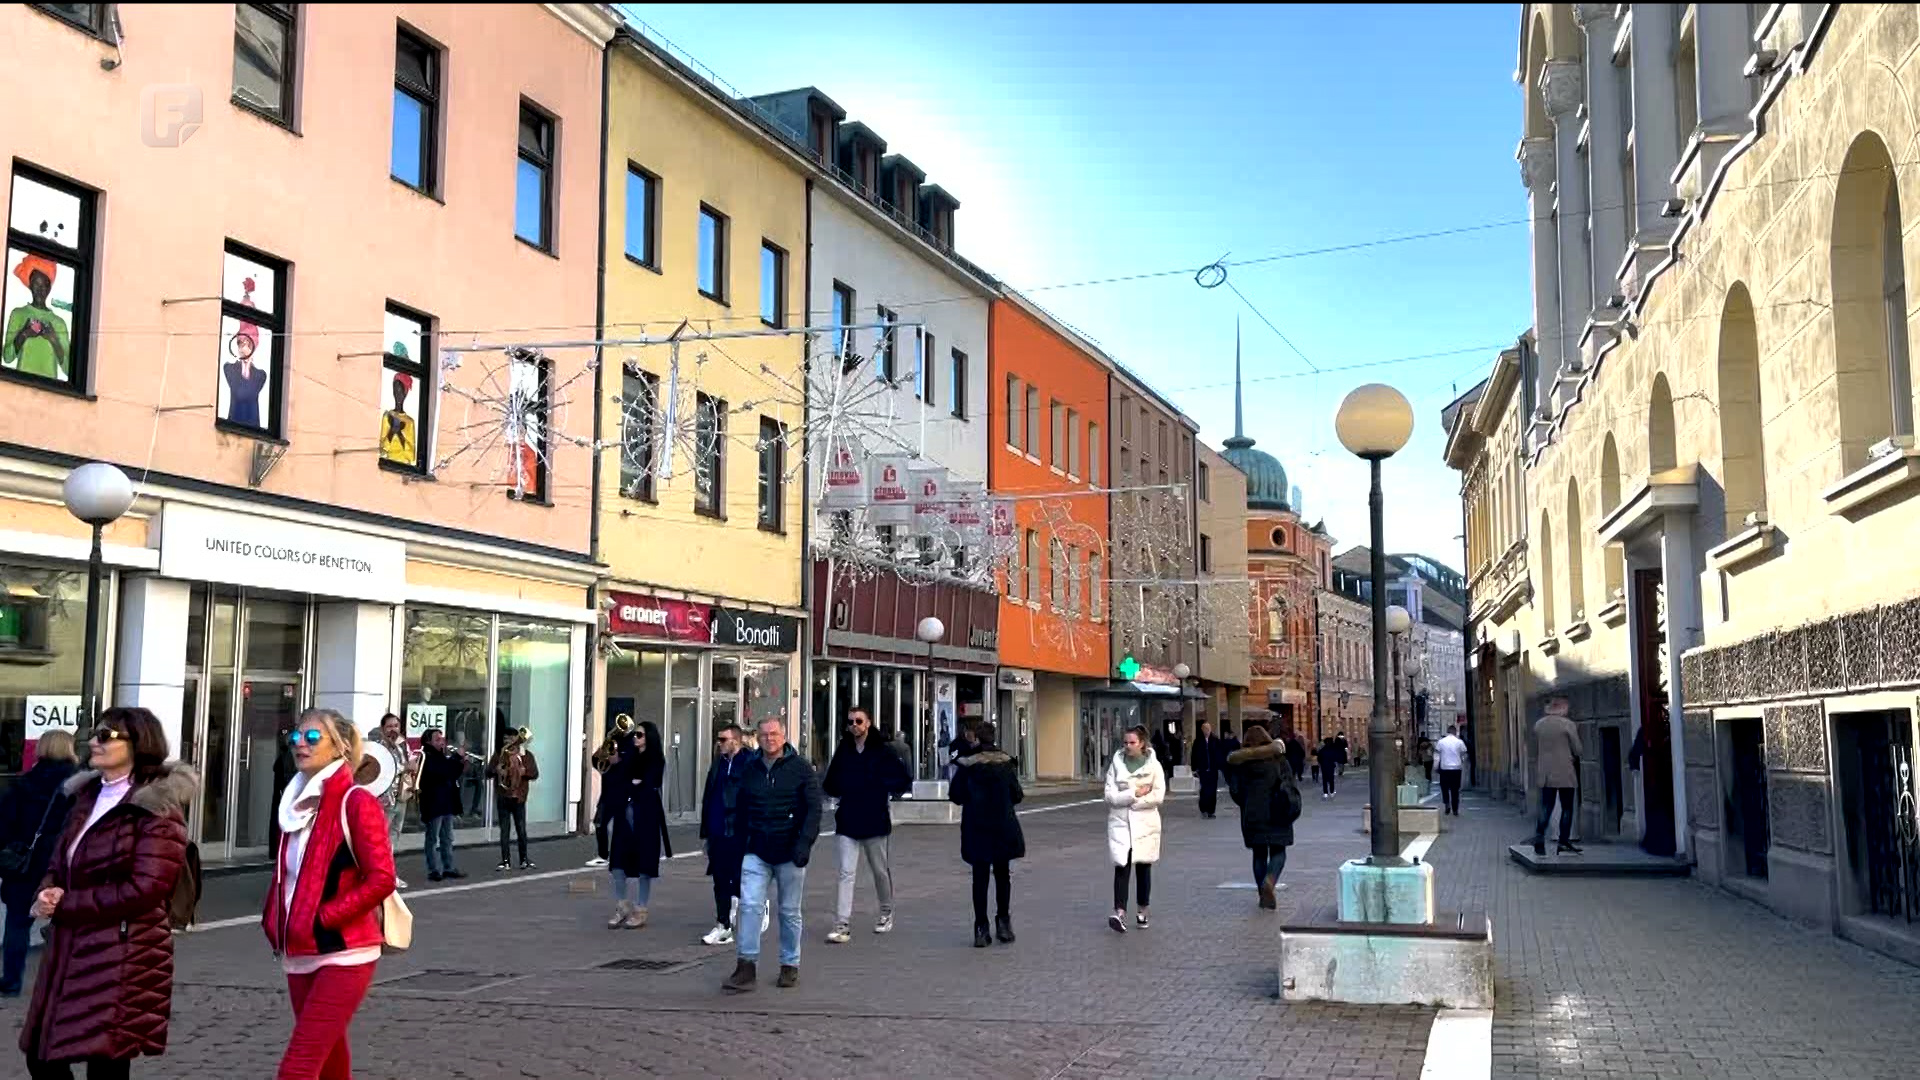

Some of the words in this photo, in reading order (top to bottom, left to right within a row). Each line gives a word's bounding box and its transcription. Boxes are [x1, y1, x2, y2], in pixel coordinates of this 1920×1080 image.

[206, 538, 252, 556] UNITED
[254, 544, 301, 563] COLORS
[302, 551, 317, 565] OF
[621, 605, 668, 625] eronet
[736, 617, 781, 647] Bonatti
[410, 711, 444, 728] SALE
